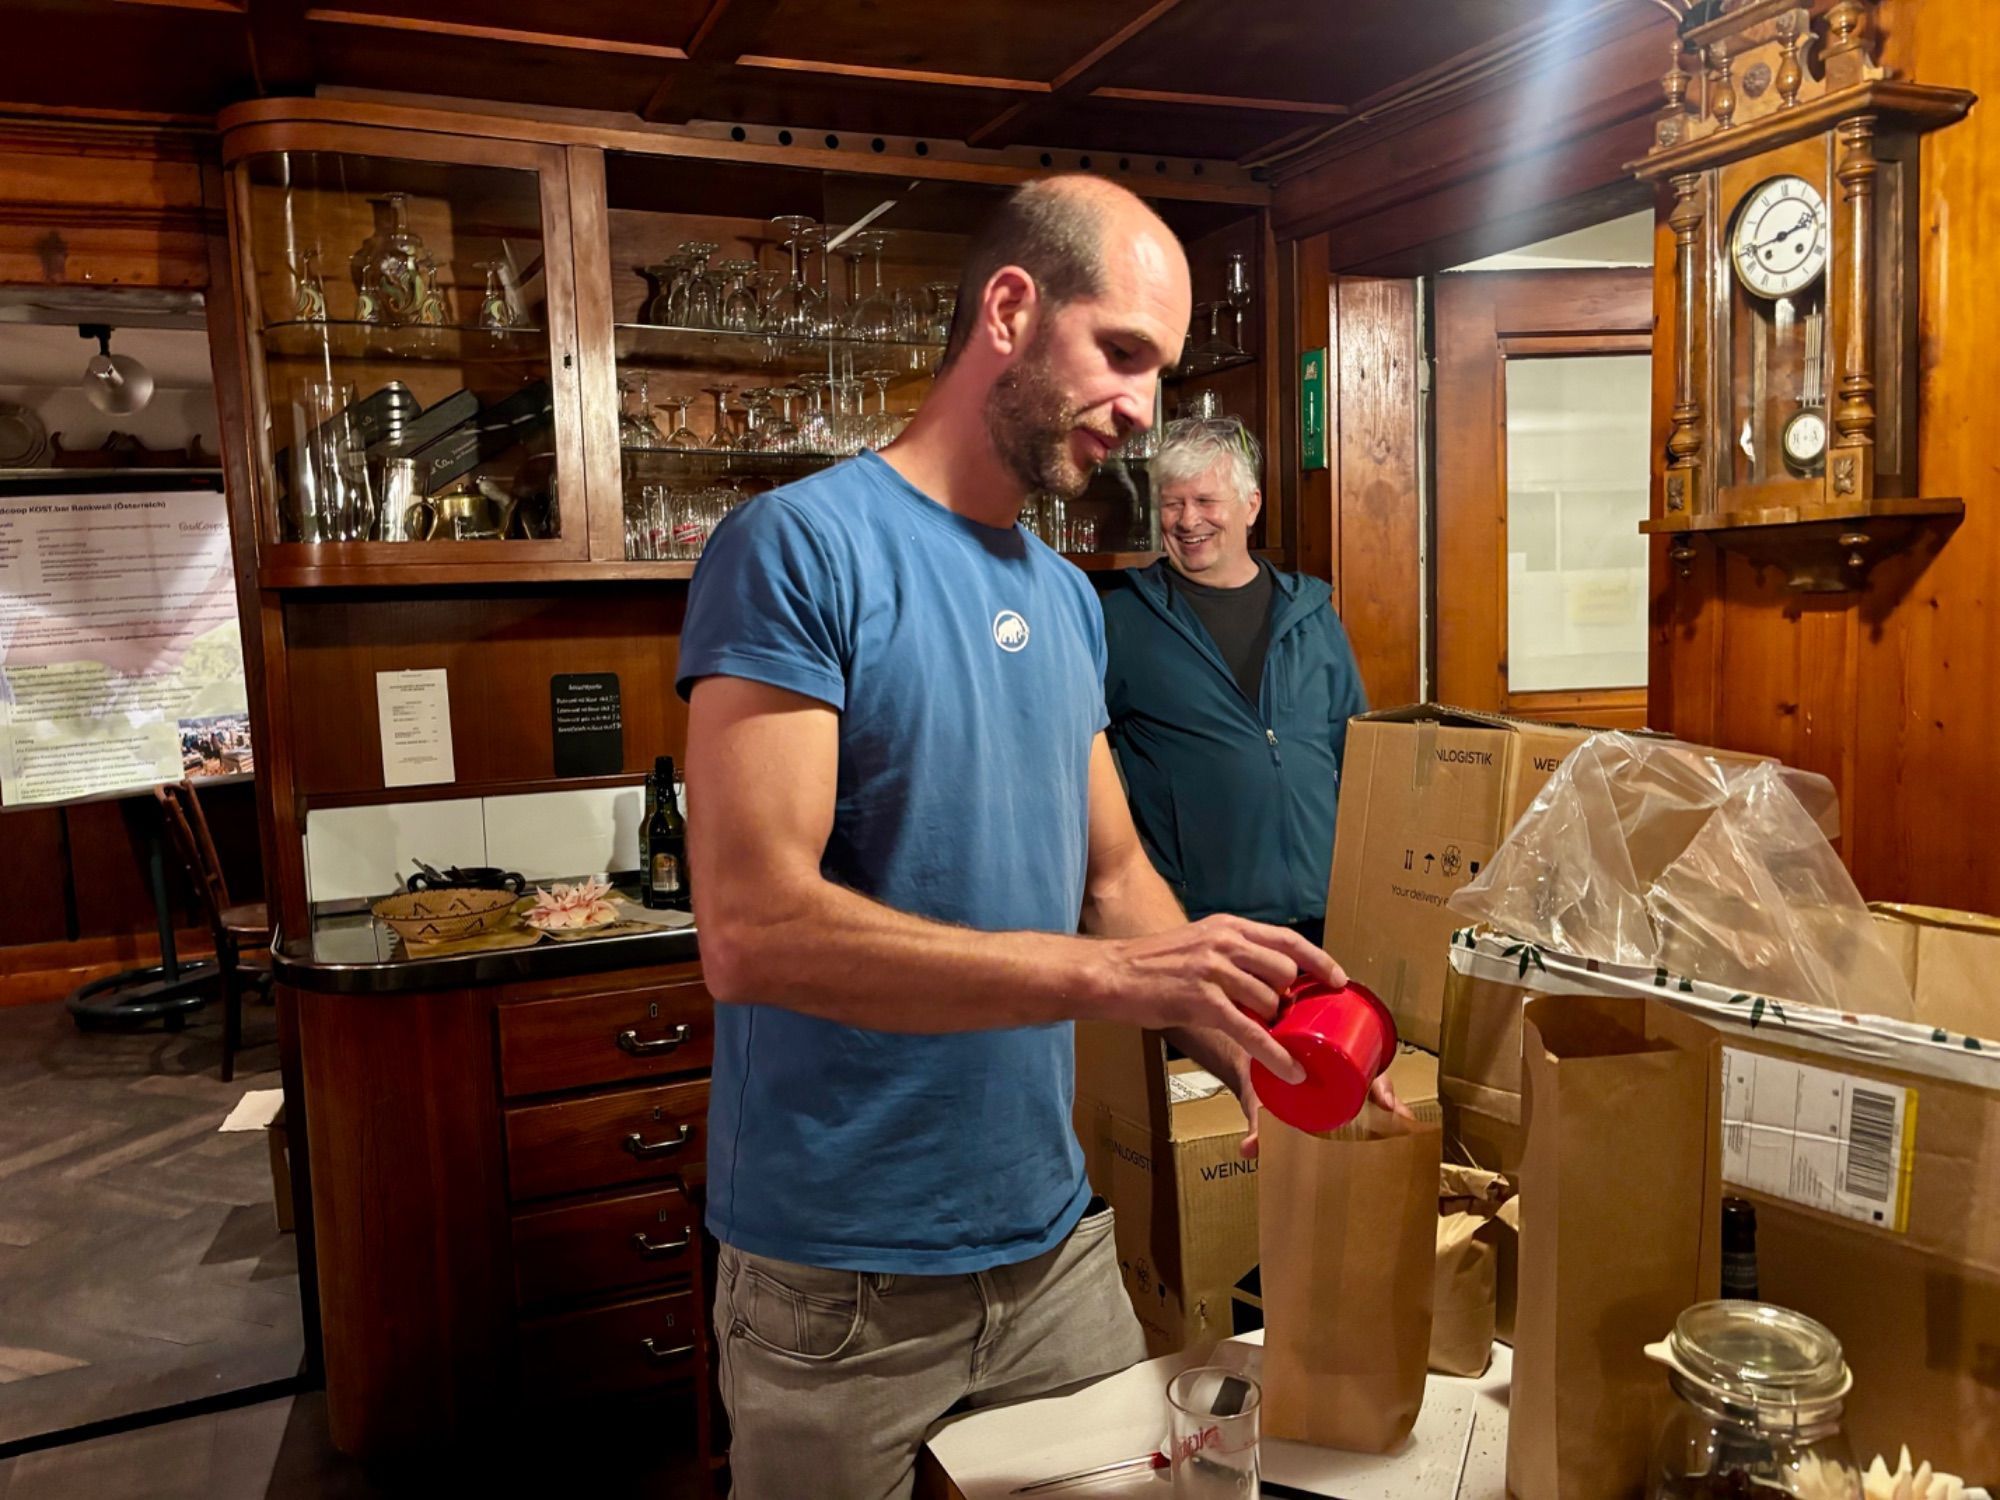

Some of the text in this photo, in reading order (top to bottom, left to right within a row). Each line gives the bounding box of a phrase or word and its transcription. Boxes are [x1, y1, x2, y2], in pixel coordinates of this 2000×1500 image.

[1436, 749, 1493, 766] NLOGISTIK
[1533, 757, 1563, 772] WEI
[1200, 1159, 1259, 1181] WEINL
